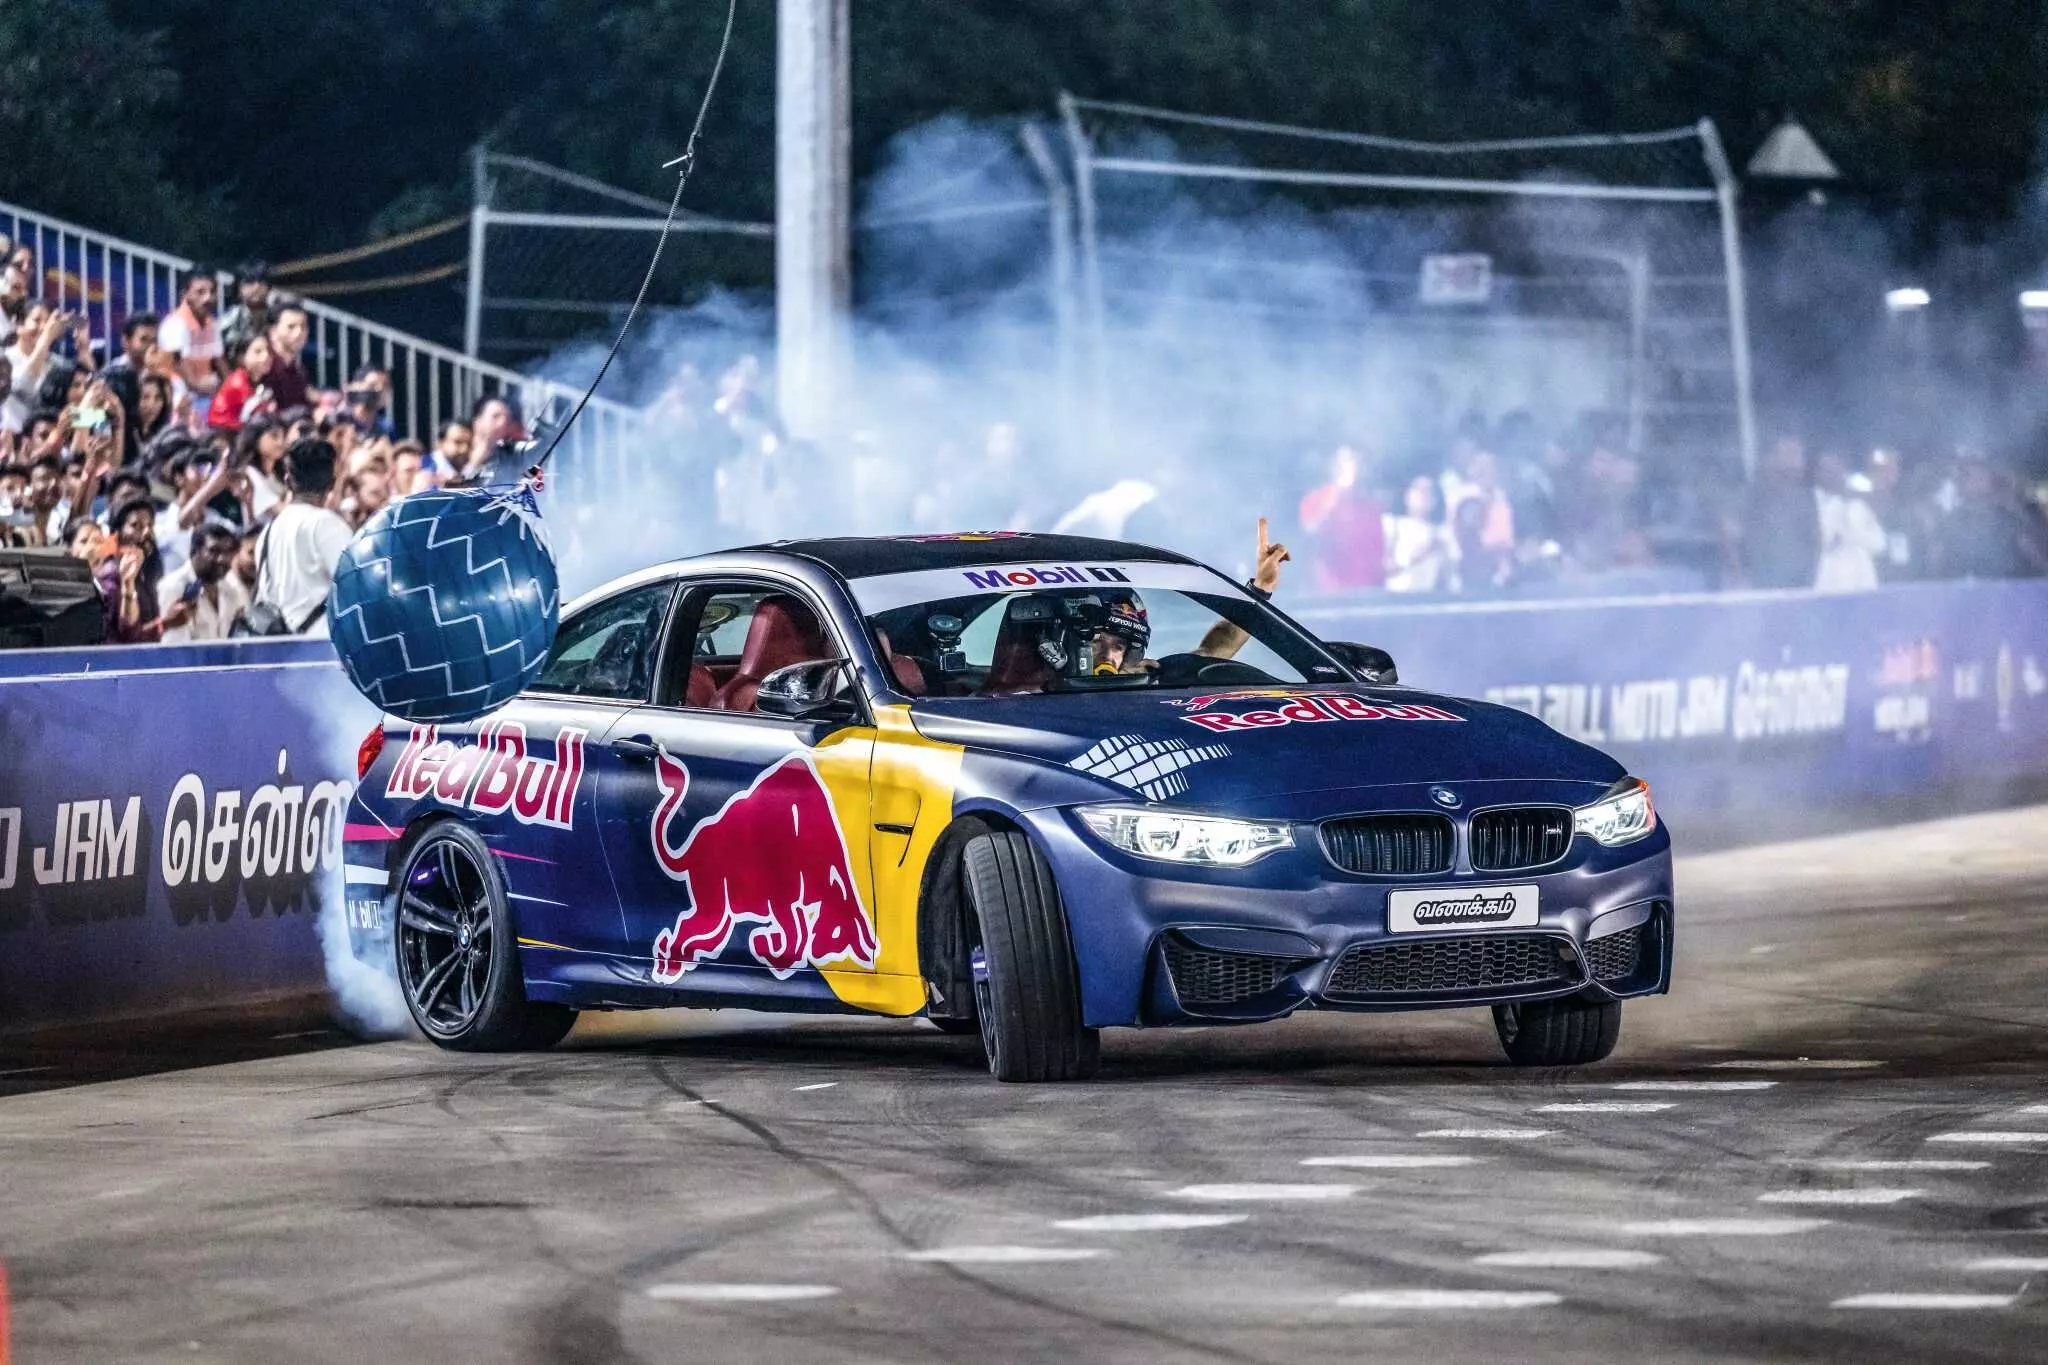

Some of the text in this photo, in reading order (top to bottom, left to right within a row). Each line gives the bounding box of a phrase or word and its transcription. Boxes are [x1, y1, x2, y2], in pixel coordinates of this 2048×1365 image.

[962, 566, 1089, 589] Mobil
[1181, 697, 1340, 732] Red
[1316, 697, 1467, 721] Bull
[386, 721, 589, 830] Red Bull
[34, 796, 141, 885] JAM
[1414, 892, 1517, 925] வணக்கம்
